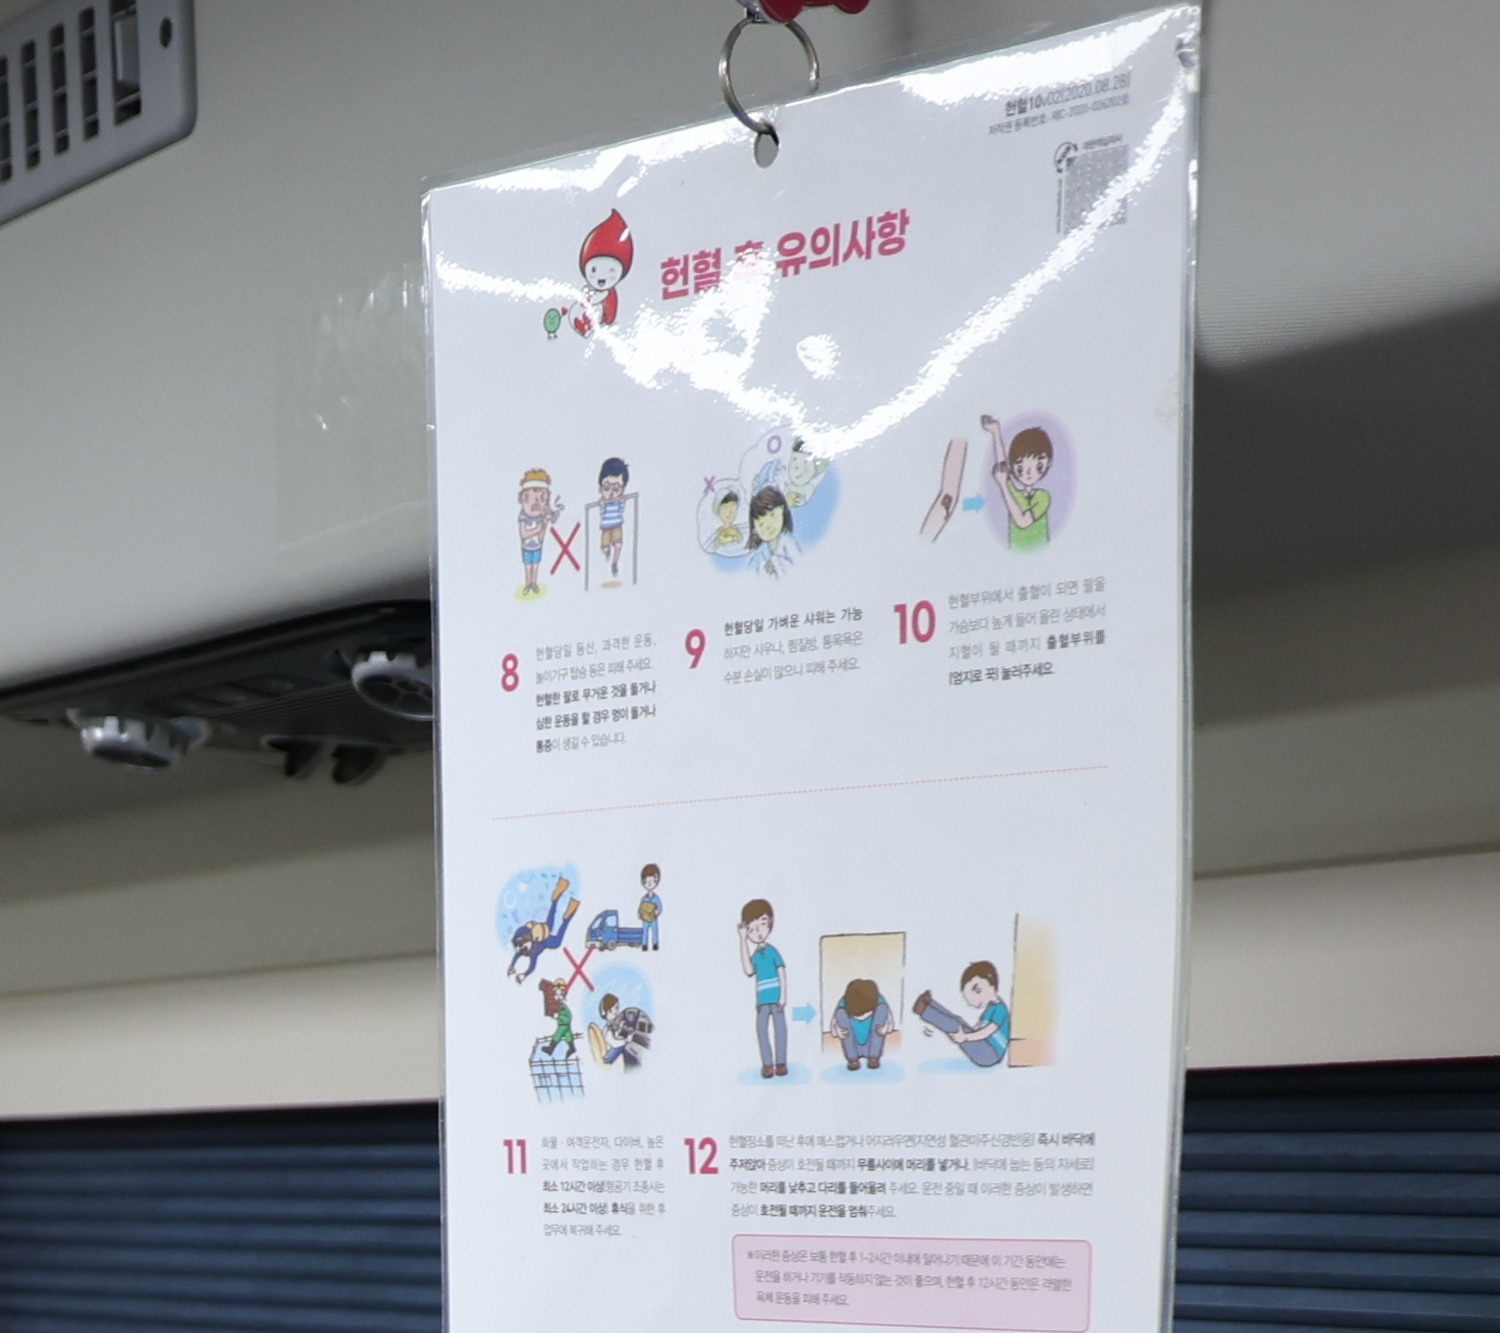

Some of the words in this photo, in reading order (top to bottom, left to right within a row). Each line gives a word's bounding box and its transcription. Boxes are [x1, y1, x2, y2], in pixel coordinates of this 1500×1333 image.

[661, 248, 722, 300] 헌혈
[777, 208, 910, 278] 유의사항
[1056, 581, 1079, 595] 되면
[1083, 576, 1105, 593] 팔을
[724, 619, 764, 636] 헌혈당일
[768, 614, 800, 630] 가벼운
[804, 610, 836, 625] 샤워는
[841, 607, 863, 621] 가능
[894, 600, 936, 645] 10
[685, 629, 706, 669] 9
[501, 653, 519, 692] 8
[536, 692, 561, 707] 헌혈한
[582, 686, 608, 701] 무거운
[611, 683, 628, 698] 것을
[630, 681, 657, 696] 들거나
[536, 716, 552, 730] 심한
[554, 713, 579, 728] 운동을
[592, 709, 609, 724] 경우
[611, 707, 629, 722] 멍이
[630, 705, 657, 719] 들거나
[581, 735, 589, 748] 수
[503, 1139, 527, 1174] 11
[655, 1158, 664, 1169] 후
[684, 1137, 719, 1174] 12
